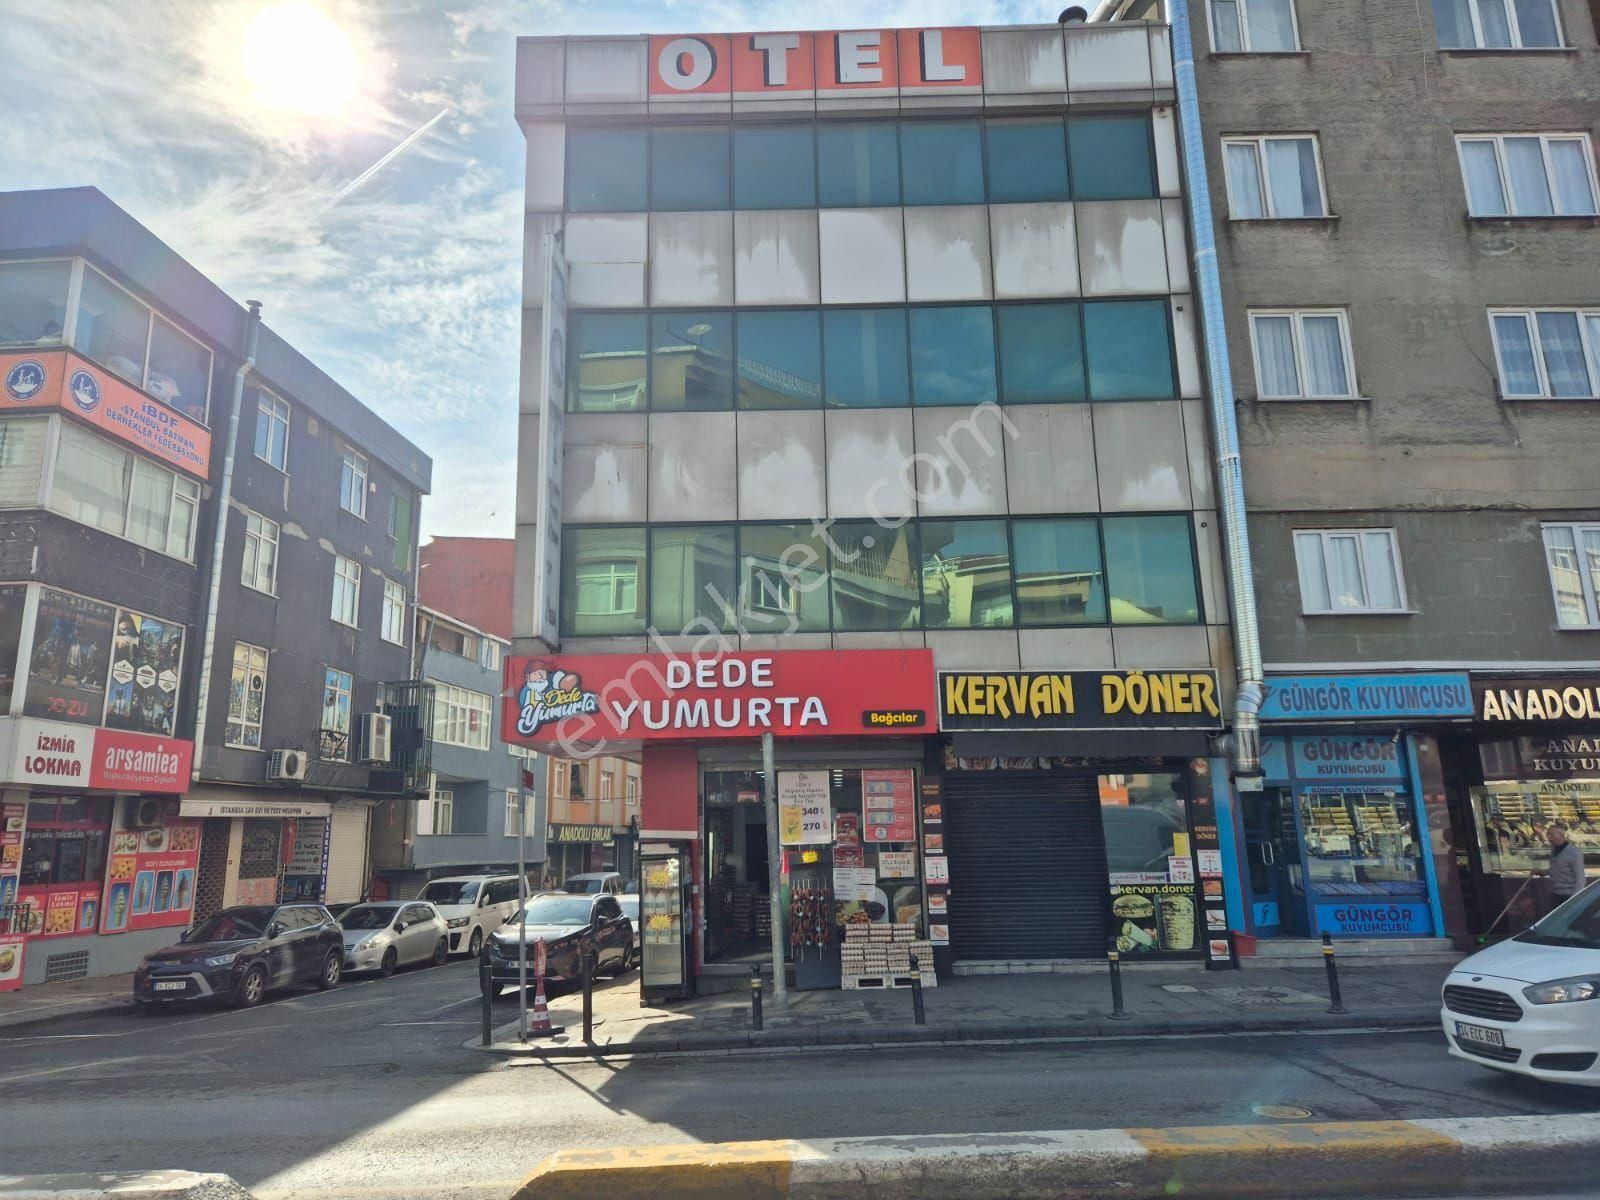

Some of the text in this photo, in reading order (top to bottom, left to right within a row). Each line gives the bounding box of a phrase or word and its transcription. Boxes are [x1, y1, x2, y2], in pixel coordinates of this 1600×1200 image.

[658, 31, 966, 90] OTEL
[666, 658, 774, 690] DEDE
[544, 687, 582, 706] Dede
[945, 667, 1220, 719] KERVAN DÖNER
[1279, 682, 1466, 711] GÜNGÖR KUYUMCUSU
[612, 696, 829, 729] YUMURTA
[1484, 687, 1600, 720] ANADOL
[871, 712, 918, 726] Bağcılar
[1303, 739, 1396, 761] GÜNGÖR
[25, 756, 81, 777] LOKMA
[1317, 764, 1386, 774] KUYUMCUSU
[1541, 783, 1591, 793] ANADOLU
[801, 807, 818, 815] 340
[560, 826, 612, 841] ANADOLU EMLAK
[803, 822, 820, 831] 270
[1118, 884, 1195, 894] kervan.doner
[1335, 904, 1413, 922] GÜNGÖR
[1341, 923, 1409, 932] KUYUMCUSU
